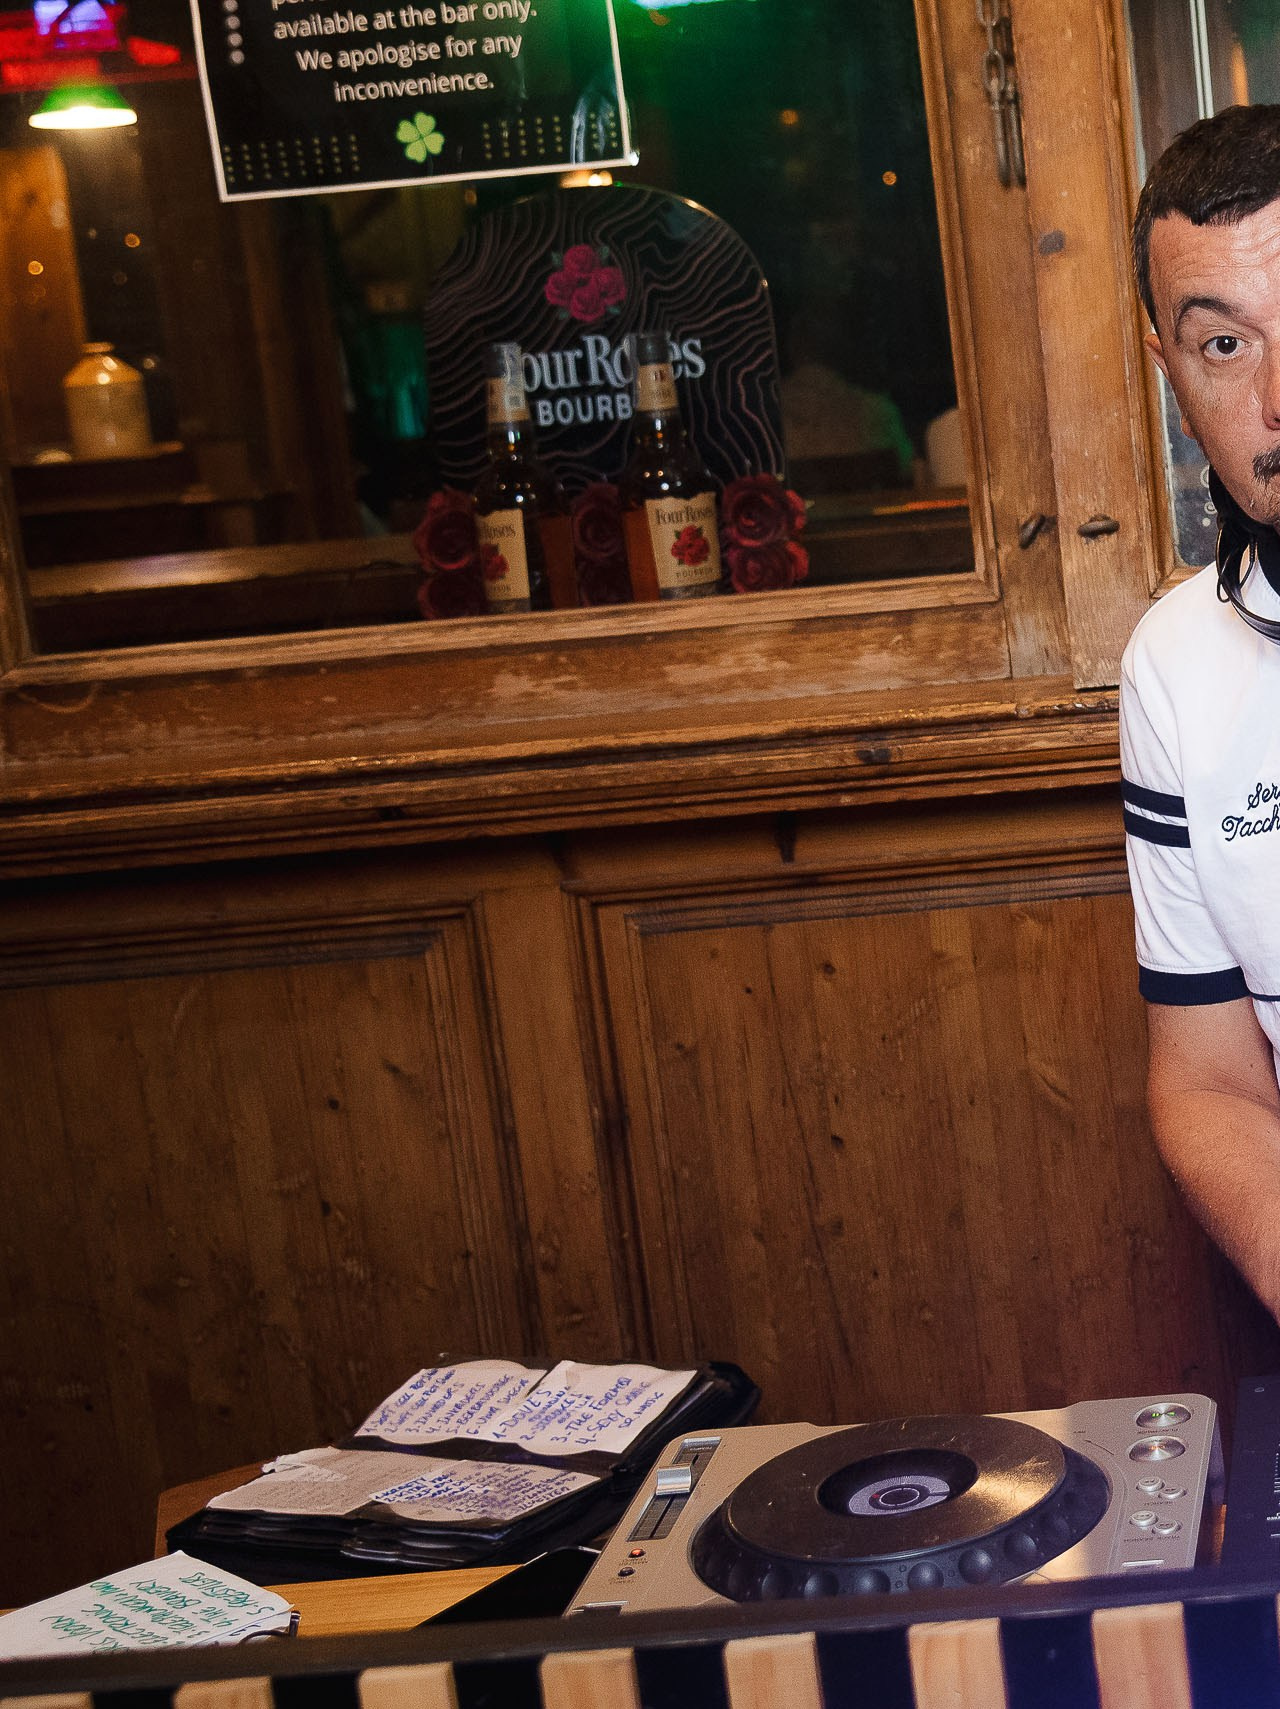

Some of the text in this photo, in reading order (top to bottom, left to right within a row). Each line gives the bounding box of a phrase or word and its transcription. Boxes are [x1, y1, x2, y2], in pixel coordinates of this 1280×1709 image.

[273, 0, 537, 40] available at the bar only.
[296, 33, 523, 73] We apologise for any
[333, 71, 496, 103] inconvenience.
[536, 392, 633, 428] BOURB
